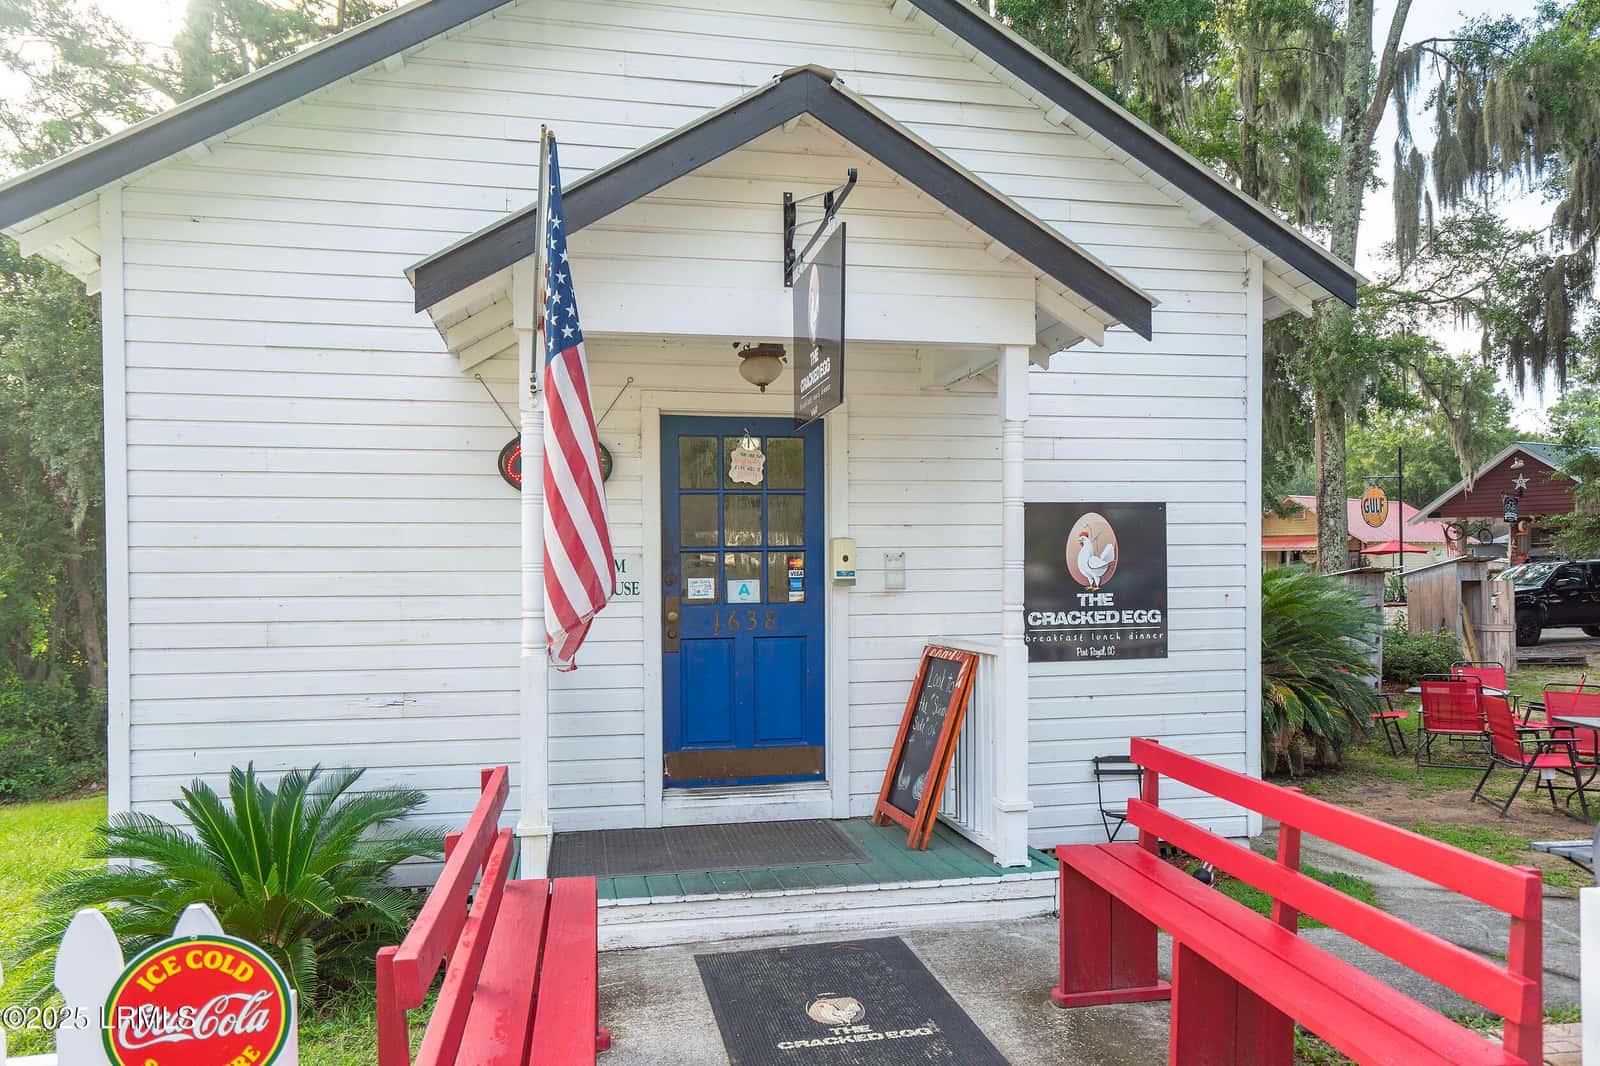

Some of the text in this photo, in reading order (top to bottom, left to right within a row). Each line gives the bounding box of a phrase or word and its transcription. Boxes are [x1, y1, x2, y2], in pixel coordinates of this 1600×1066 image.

[809, 346, 819, 368] THE
[1363, 497, 1385, 514] GULF
[614, 559, 626, 573] M
[614, 581, 640, 595] USE
[738, 583, 751, 596] A
[1076, 592, 1114, 607] THE
[712, 609, 779, 635] 1638
[1027, 609, 1162, 626] CRACKED EGG
[1025, 631, 1164, 643] breakfast lunch dinner
[136, 949, 255, 993] ICE COLD
[829, 1024, 873, 1036] THE
[776, 1032, 885, 1050] CRACKED
